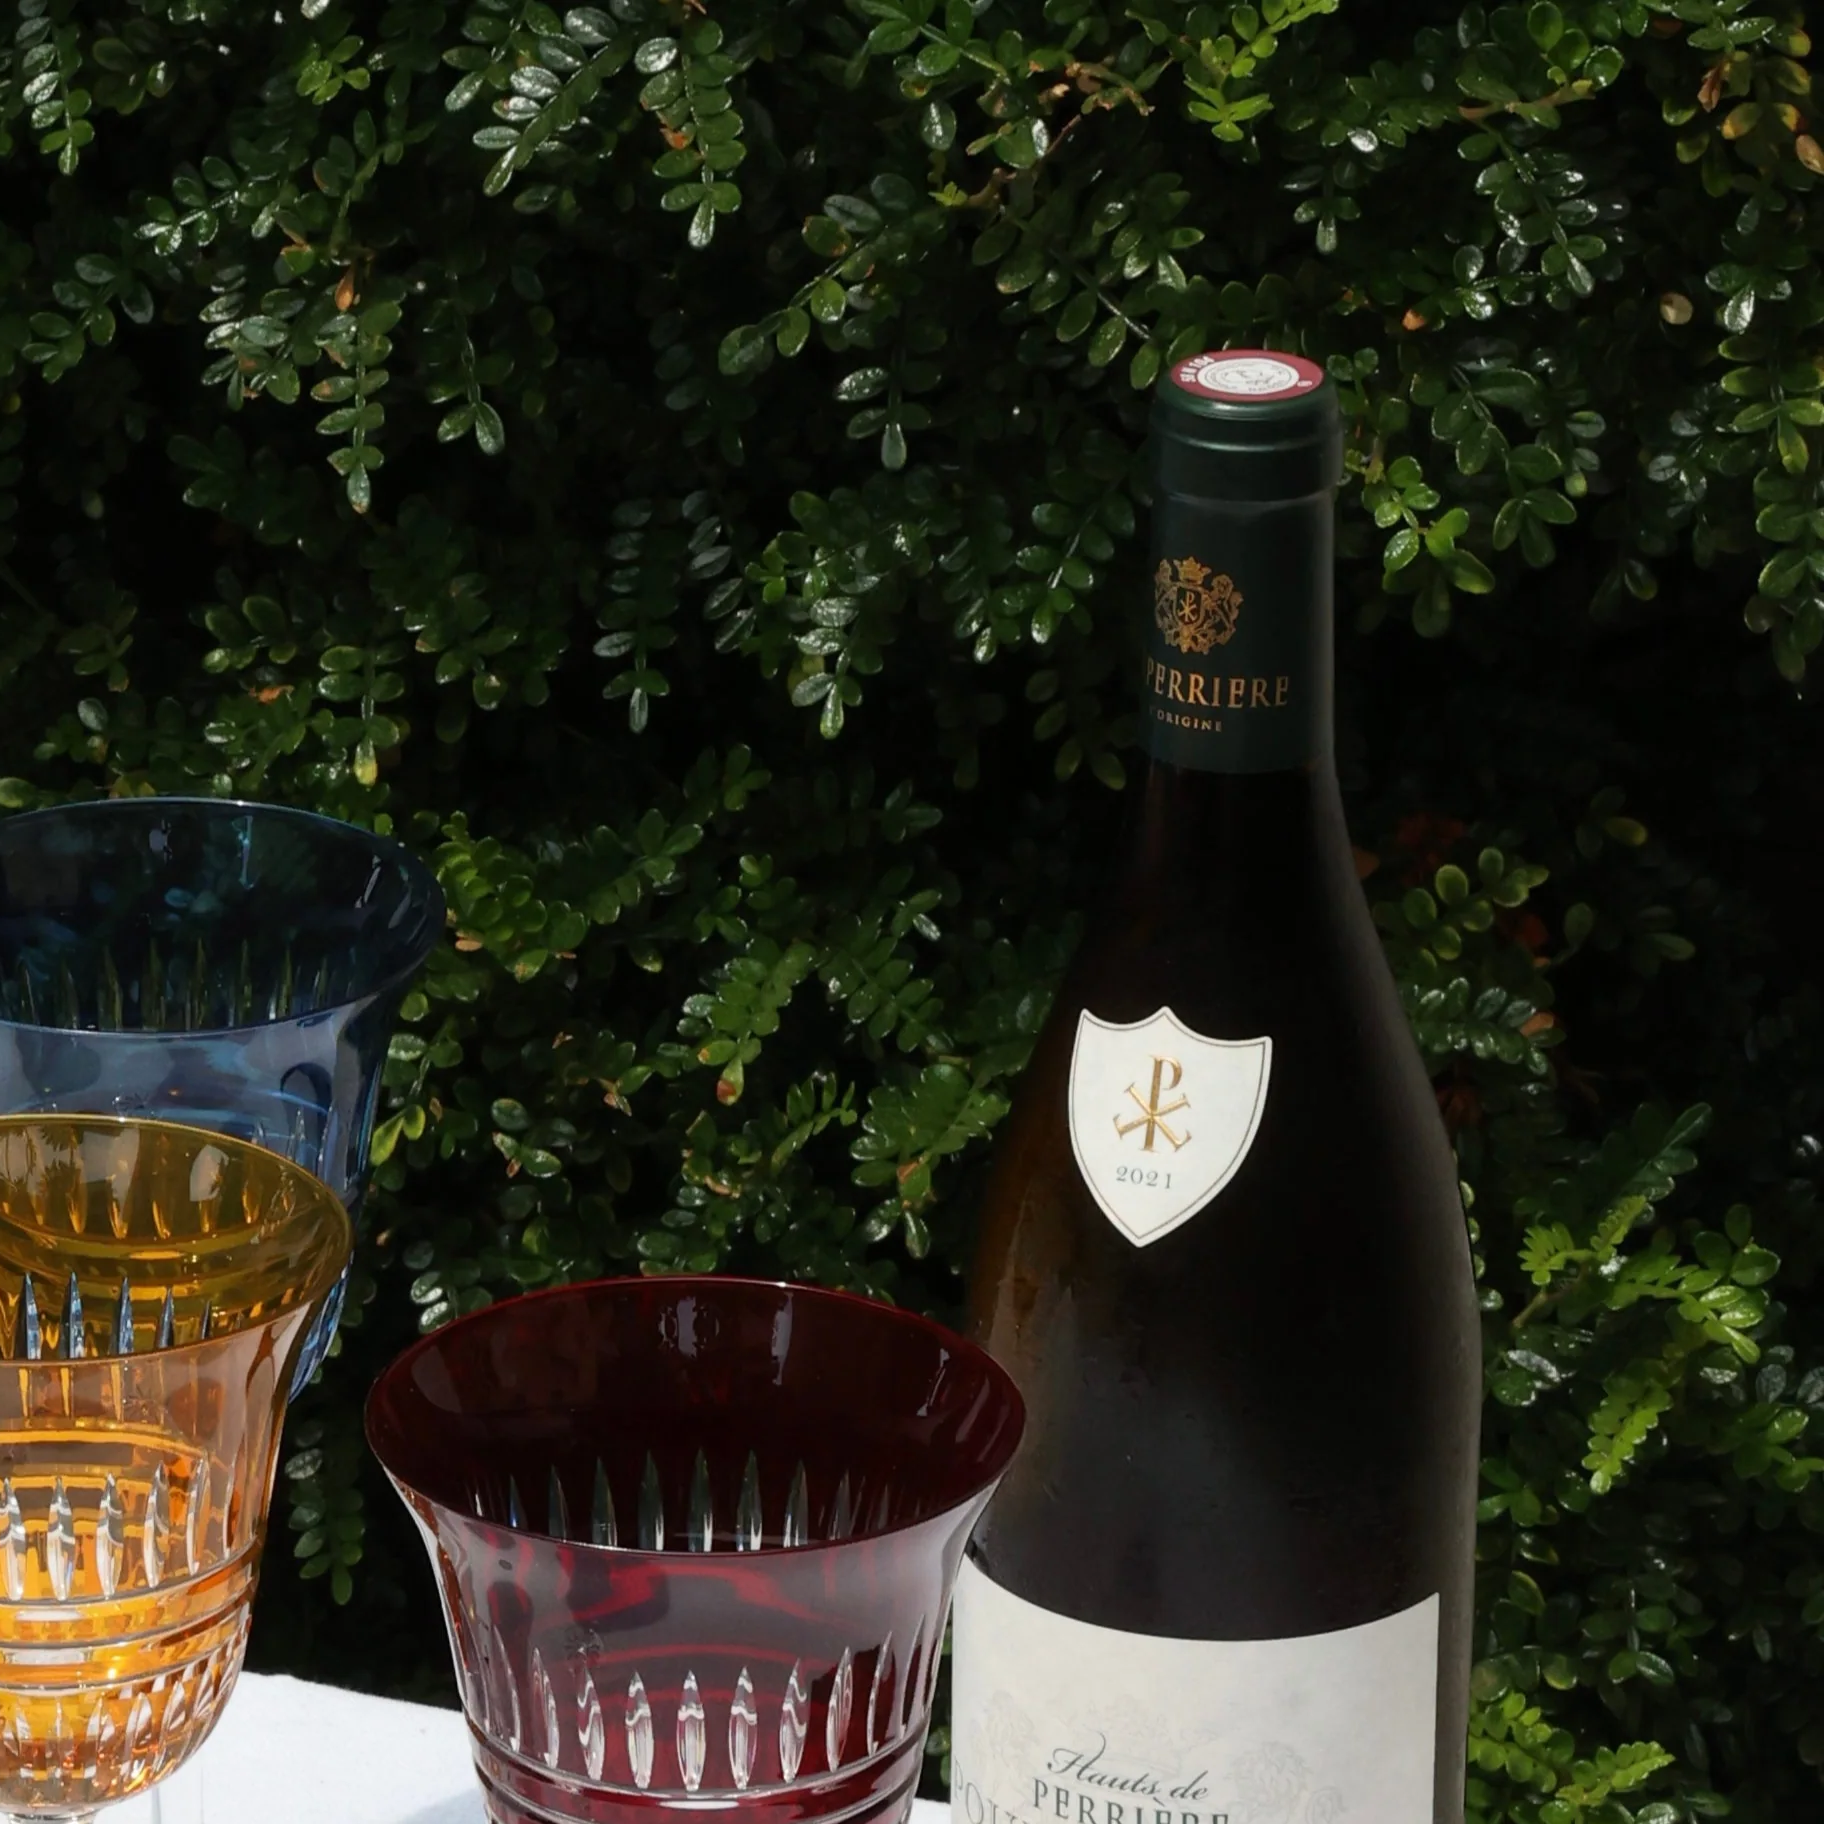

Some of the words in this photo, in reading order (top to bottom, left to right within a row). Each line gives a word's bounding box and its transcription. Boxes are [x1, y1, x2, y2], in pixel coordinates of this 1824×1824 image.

[1116, 1165, 1172, 1190] 2021
[1046, 1731, 1161, 1796] Hauts
[1169, 1769, 1209, 1801] de
